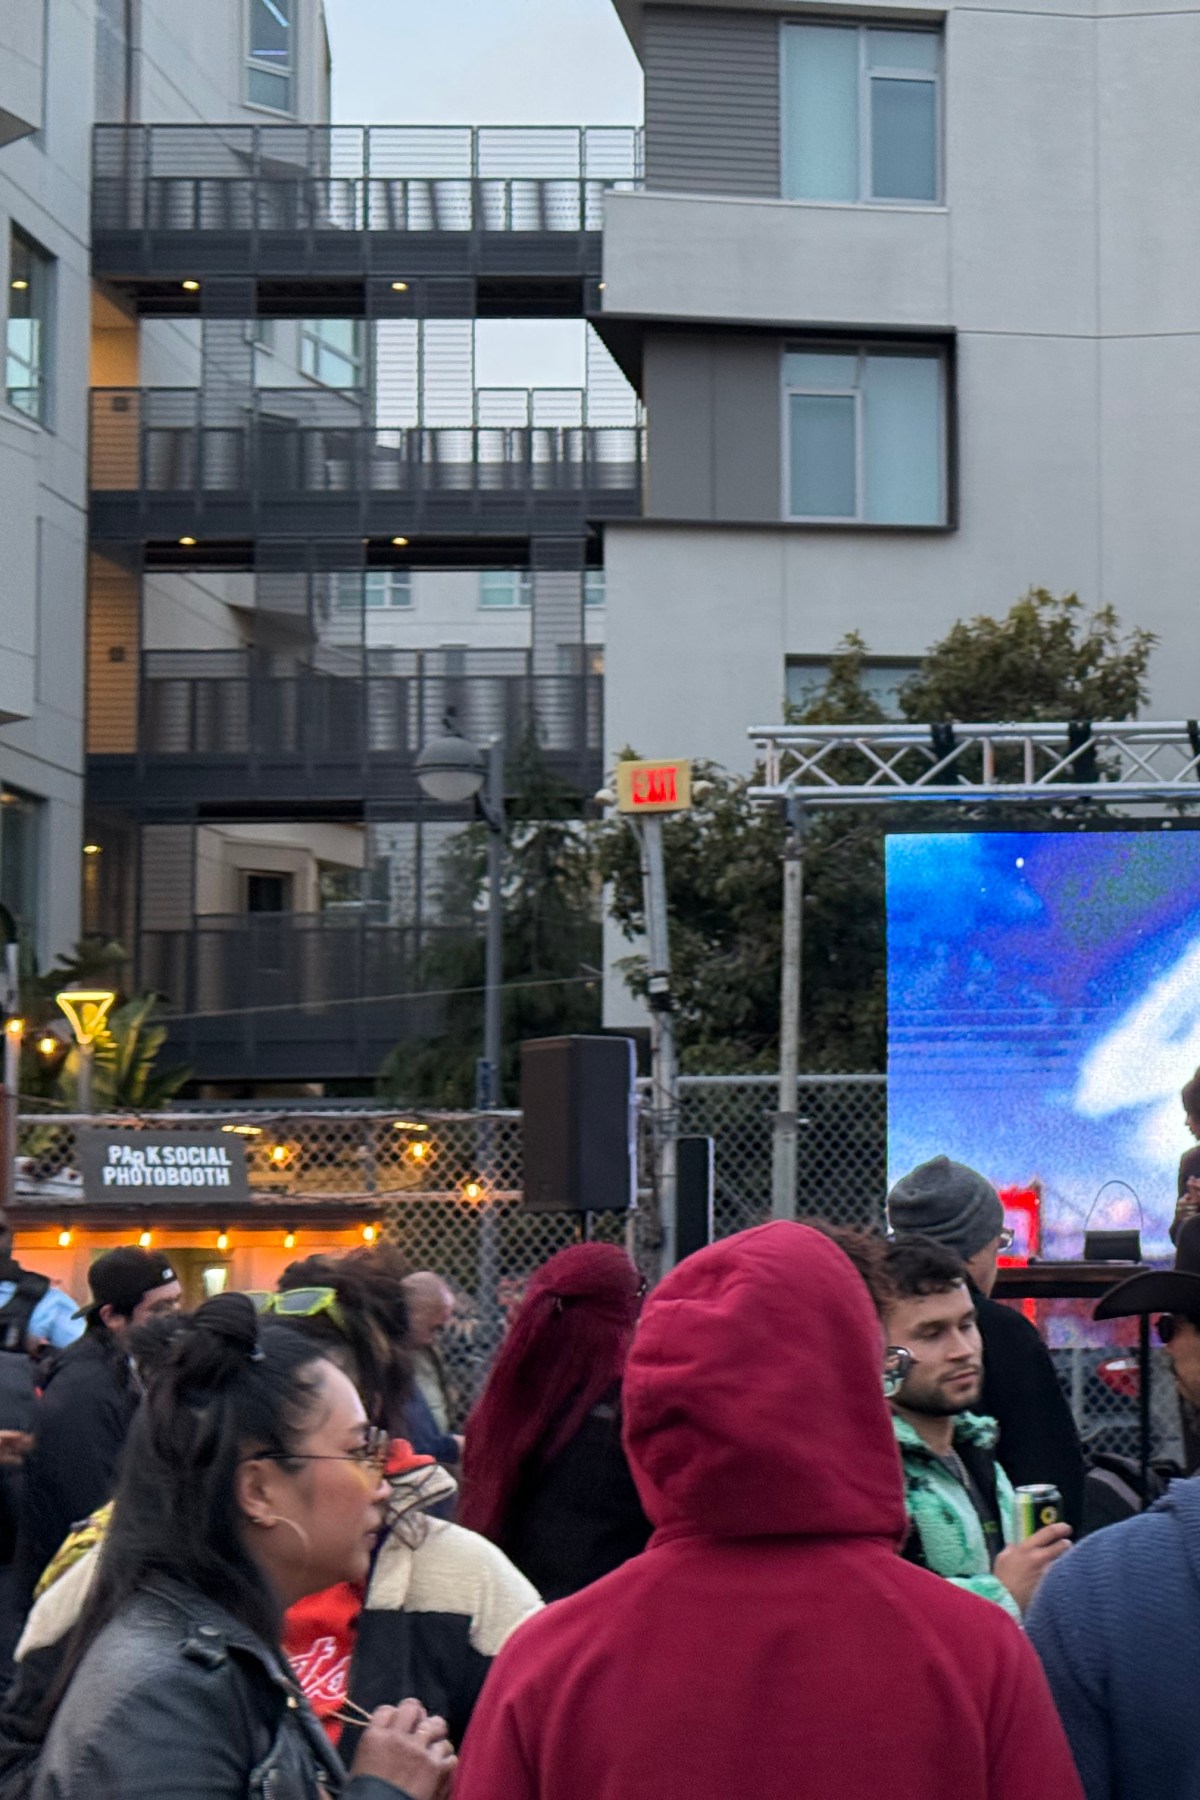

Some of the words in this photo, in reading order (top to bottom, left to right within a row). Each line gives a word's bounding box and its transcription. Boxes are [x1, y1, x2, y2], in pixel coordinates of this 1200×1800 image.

[631, 766, 677, 804] EXIT
[108, 1145, 161, 1171] PARK
[162, 1147, 233, 1166] SOCIAL
[103, 1166, 231, 1186] PHOTOBOOTH
